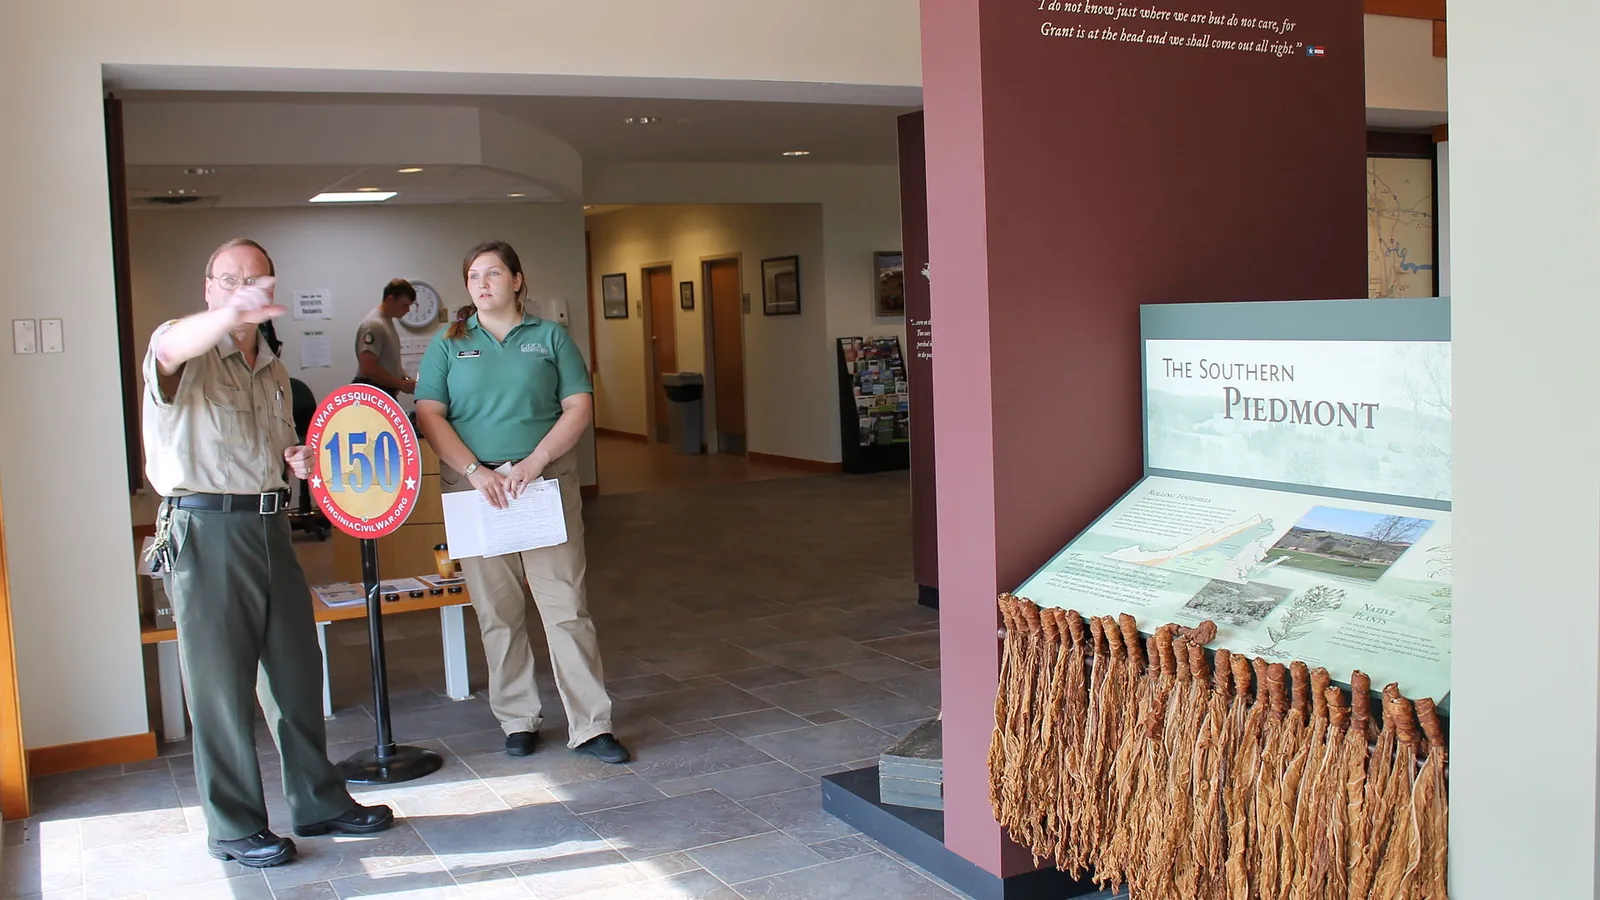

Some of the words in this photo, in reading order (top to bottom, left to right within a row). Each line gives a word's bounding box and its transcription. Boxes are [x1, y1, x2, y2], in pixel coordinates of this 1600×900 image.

[1048, 0, 1061, 11] do
[1064, 1, 1082, 13] not
[1084, 0, 1115, 15] know
[1113, 3, 1138, 20] just
[1139, 6, 1171, 20] where
[1173, 12, 1189, 22] we
[1190, 14, 1206, 24] are
[1208, 11, 1225, 25] but
[1227, 13, 1239, 27] do
[1241, 17, 1257, 28] not
[1258, 20, 1279, 33] care,
[1279, 18, 1296, 35] for
[1040, 21, 1074, 37] Grant
[1076, 24, 1086, 39] is
[1087, 28, 1100, 39] at
[1101, 27, 1118, 41] the
[1119, 28, 1146, 43] head
[1146, 31, 1166, 45] and
[1169, 34, 1185, 46] we
[1186, 34, 1210, 48] shall
[1211, 39, 1236, 50] come
[1238, 41, 1254, 51] out
[1255, 39, 1268, 53] all
[1162, 357, 1193, 379] THE
[1199, 358, 1295, 382] SOUTHERN
[1222, 386, 1380, 430] PIEDMONT
[314, 402, 336, 428] WAR
[333, 390, 417, 467] SESQUICENTENNIAL
[324, 430, 401, 494] 150
[1352, 611, 1388, 625] PLANTS
[1360, 603, 1397, 616] NATIVE
